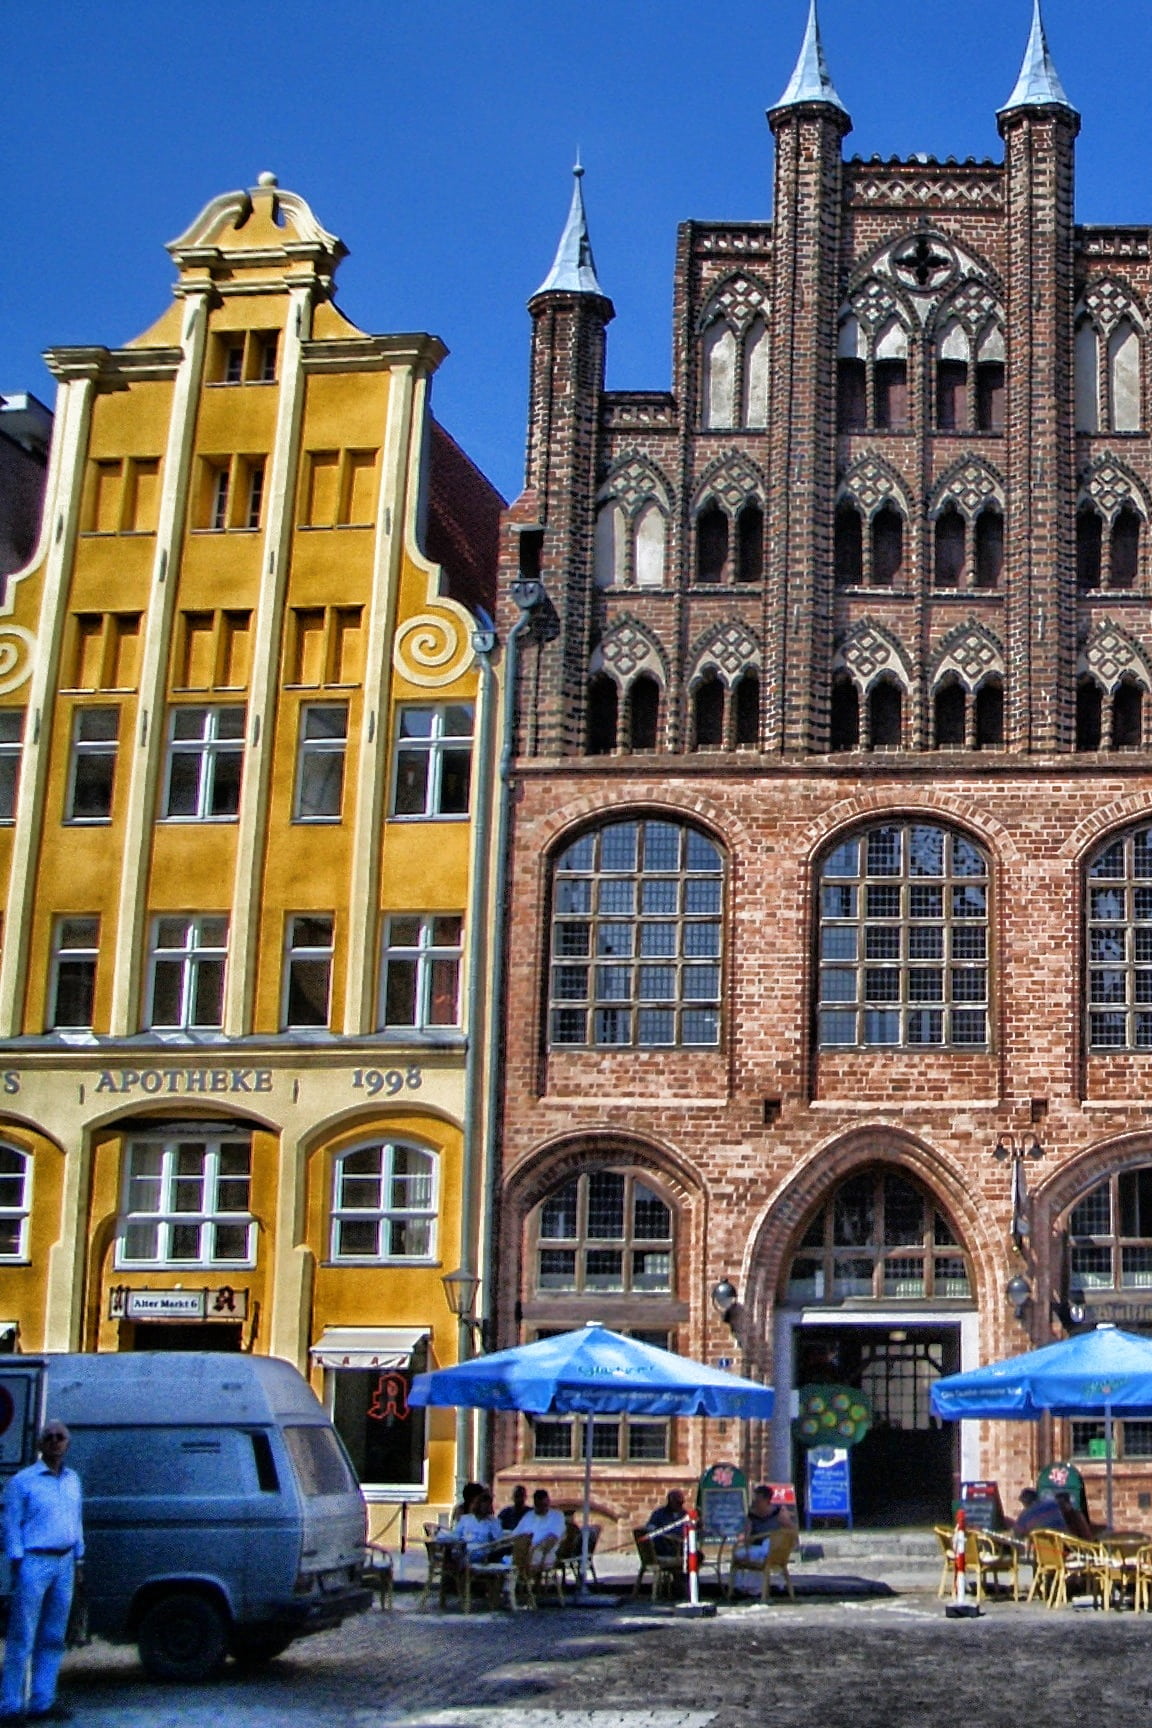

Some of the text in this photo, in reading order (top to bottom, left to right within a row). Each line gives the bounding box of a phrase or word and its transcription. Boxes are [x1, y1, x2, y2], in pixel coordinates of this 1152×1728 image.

[94, 1069, 273, 1094] APOTHEKE
[352, 1063, 422, 1097] 1998
[134, 1299, 198, 1308] Alter Markt 6
